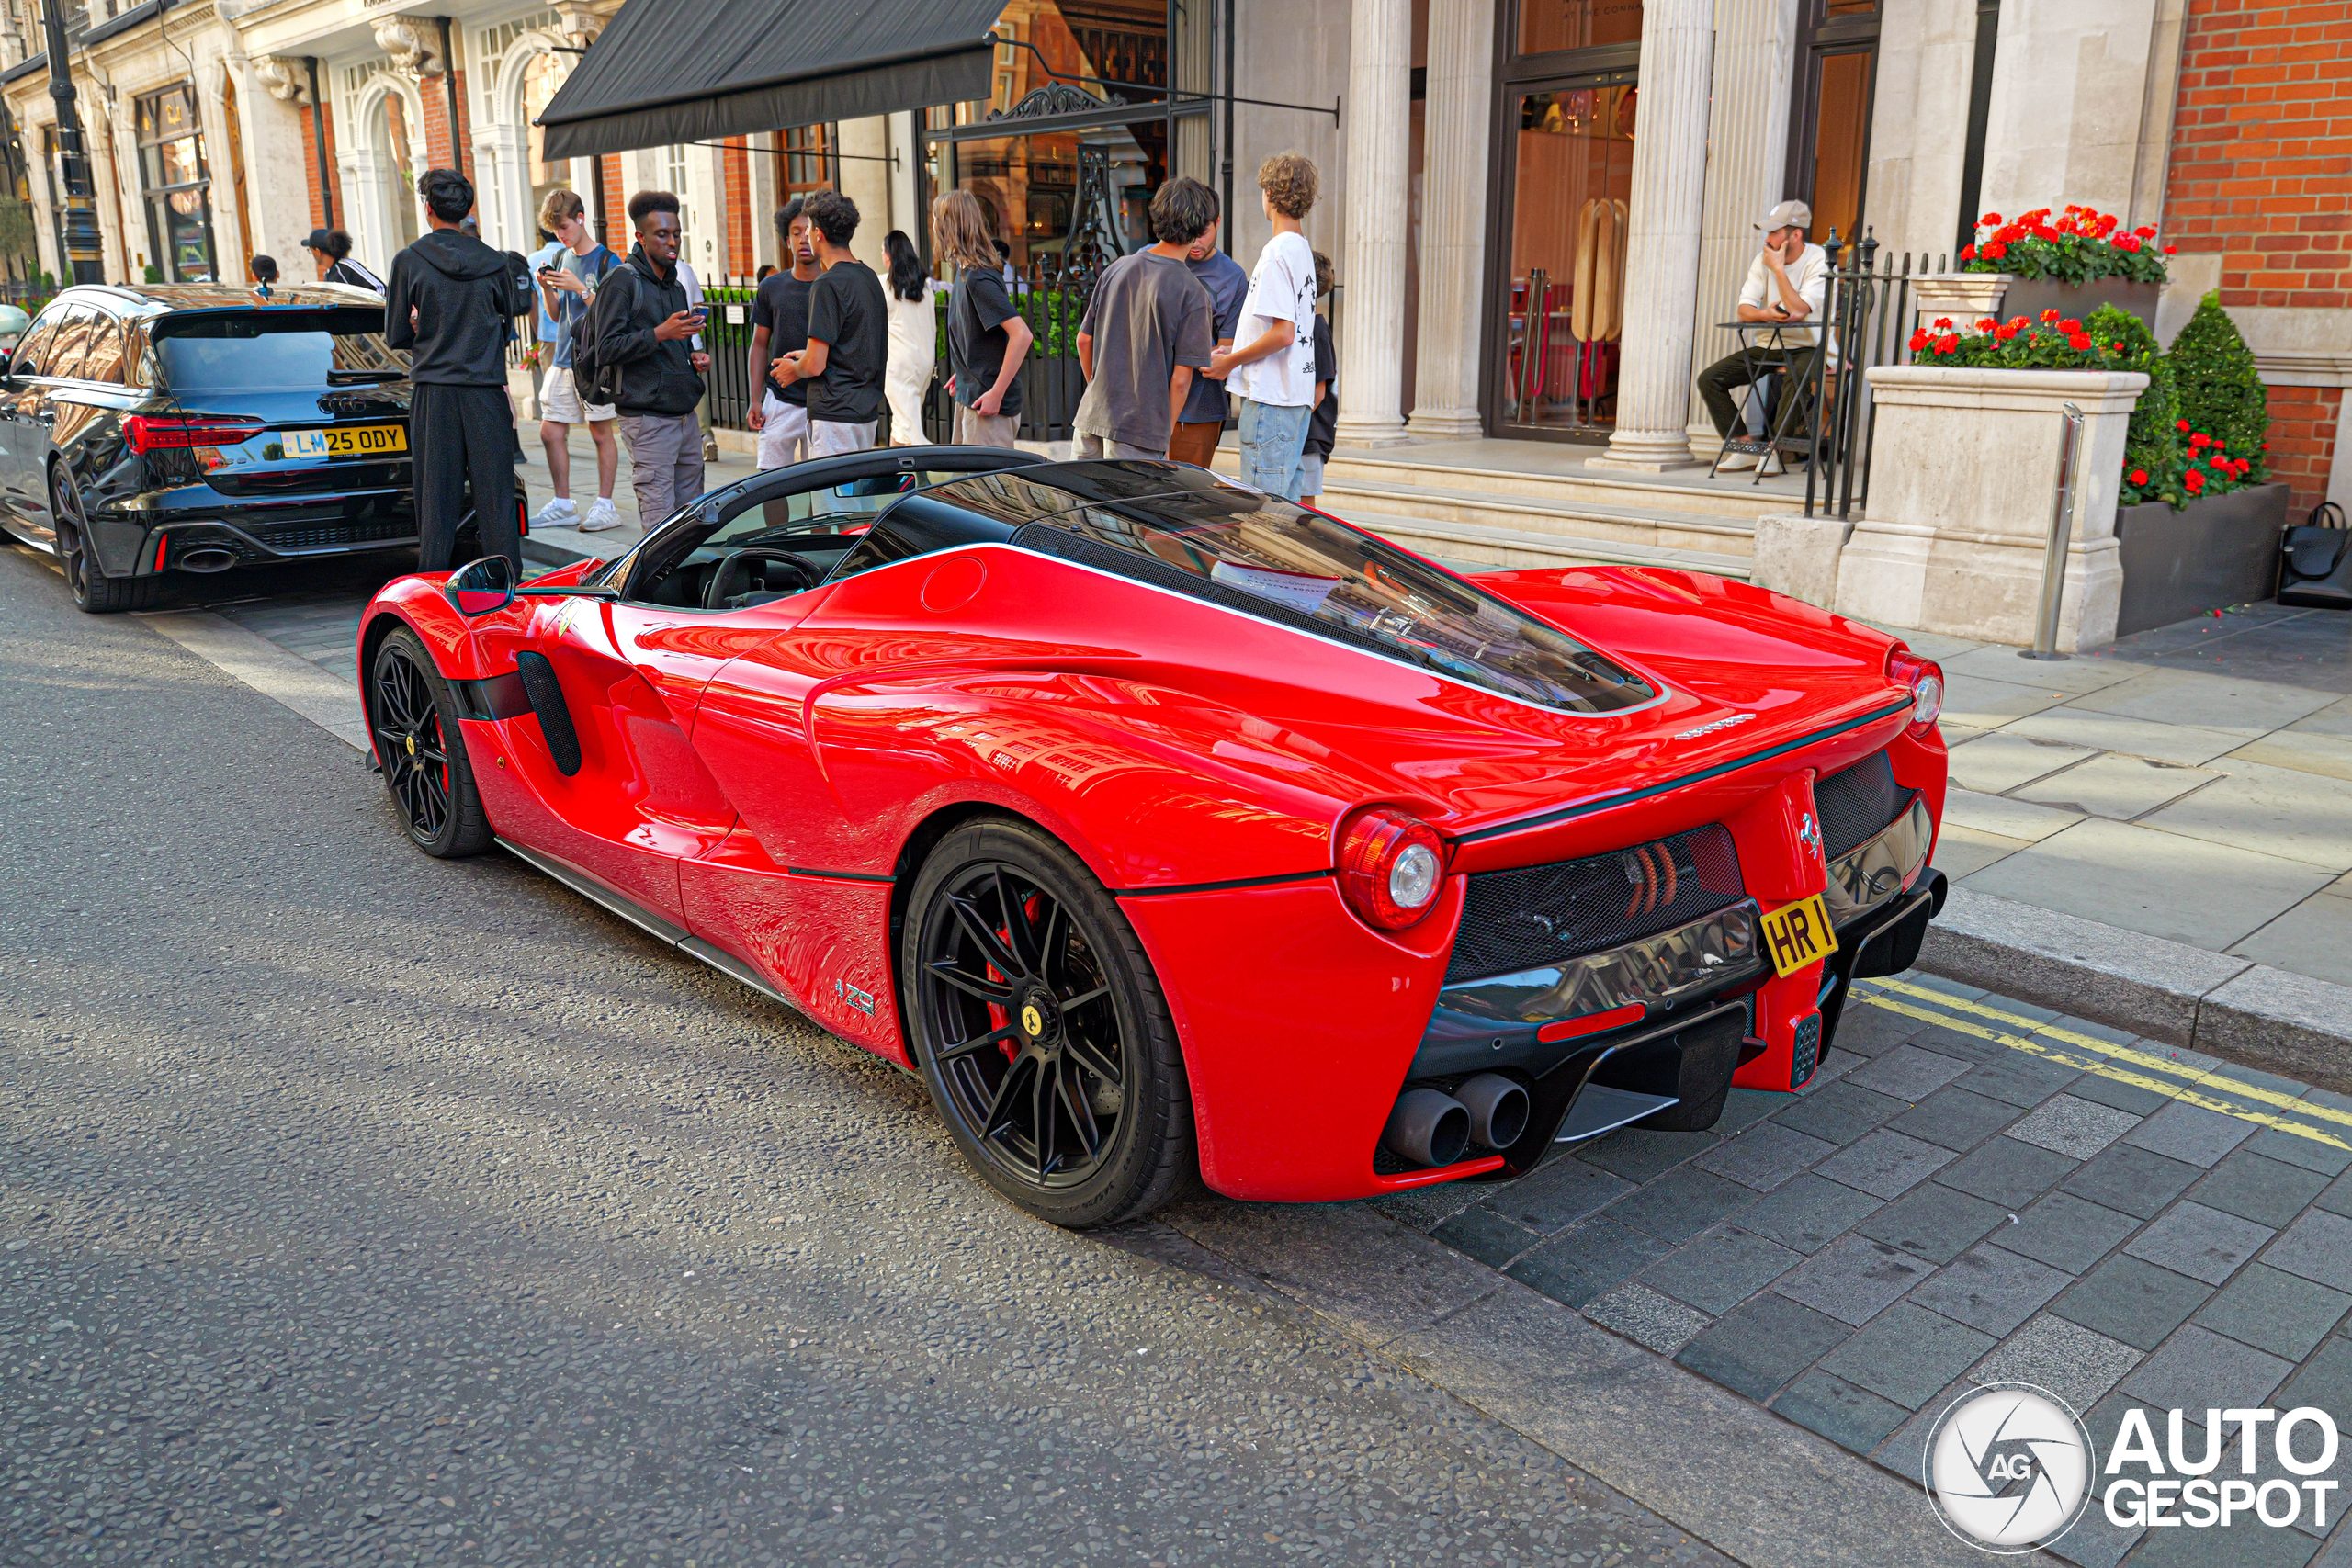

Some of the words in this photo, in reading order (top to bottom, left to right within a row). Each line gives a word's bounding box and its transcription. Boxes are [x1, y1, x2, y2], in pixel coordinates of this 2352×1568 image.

[296, 432, 354, 453] LM25
[358, 429, 398, 449] ODY
[1767, 908, 1818, 969] HR
[846, 983, 875, 1010] 70
